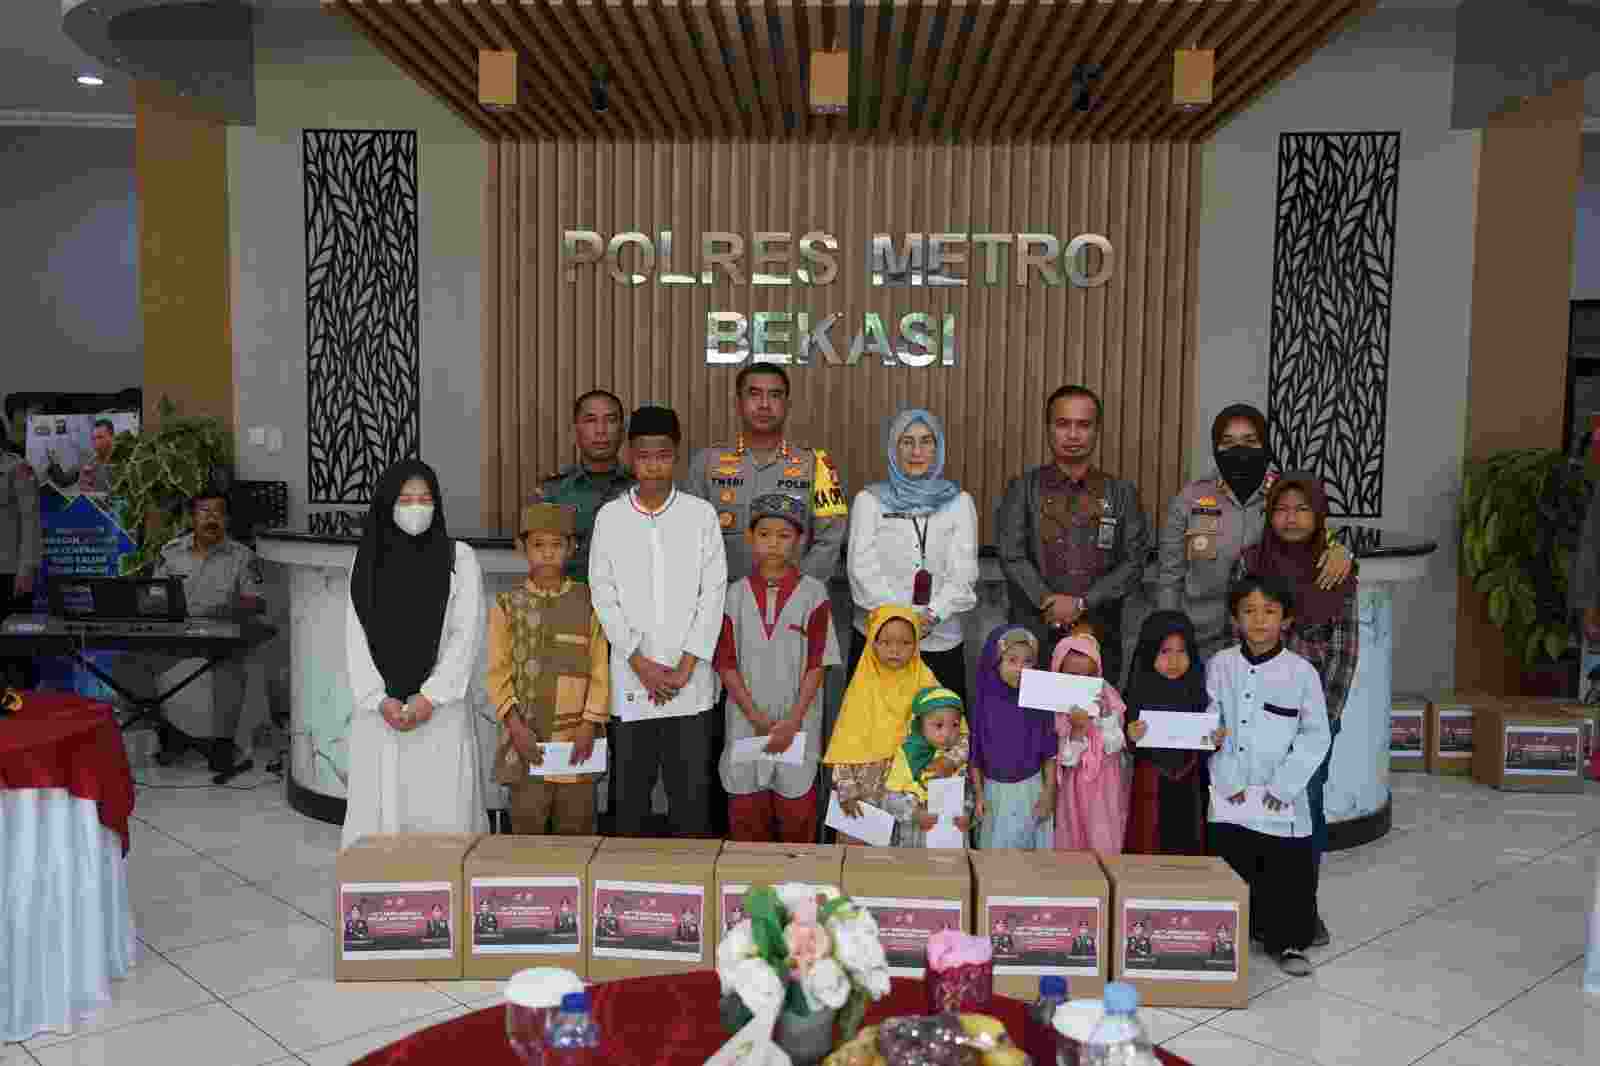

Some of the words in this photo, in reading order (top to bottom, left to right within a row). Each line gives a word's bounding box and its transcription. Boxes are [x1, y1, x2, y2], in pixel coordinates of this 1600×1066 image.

[564, 231, 839, 286] POLRES
[871, 232, 1113, 287] METRO
[706, 312, 956, 367] BEKASI
